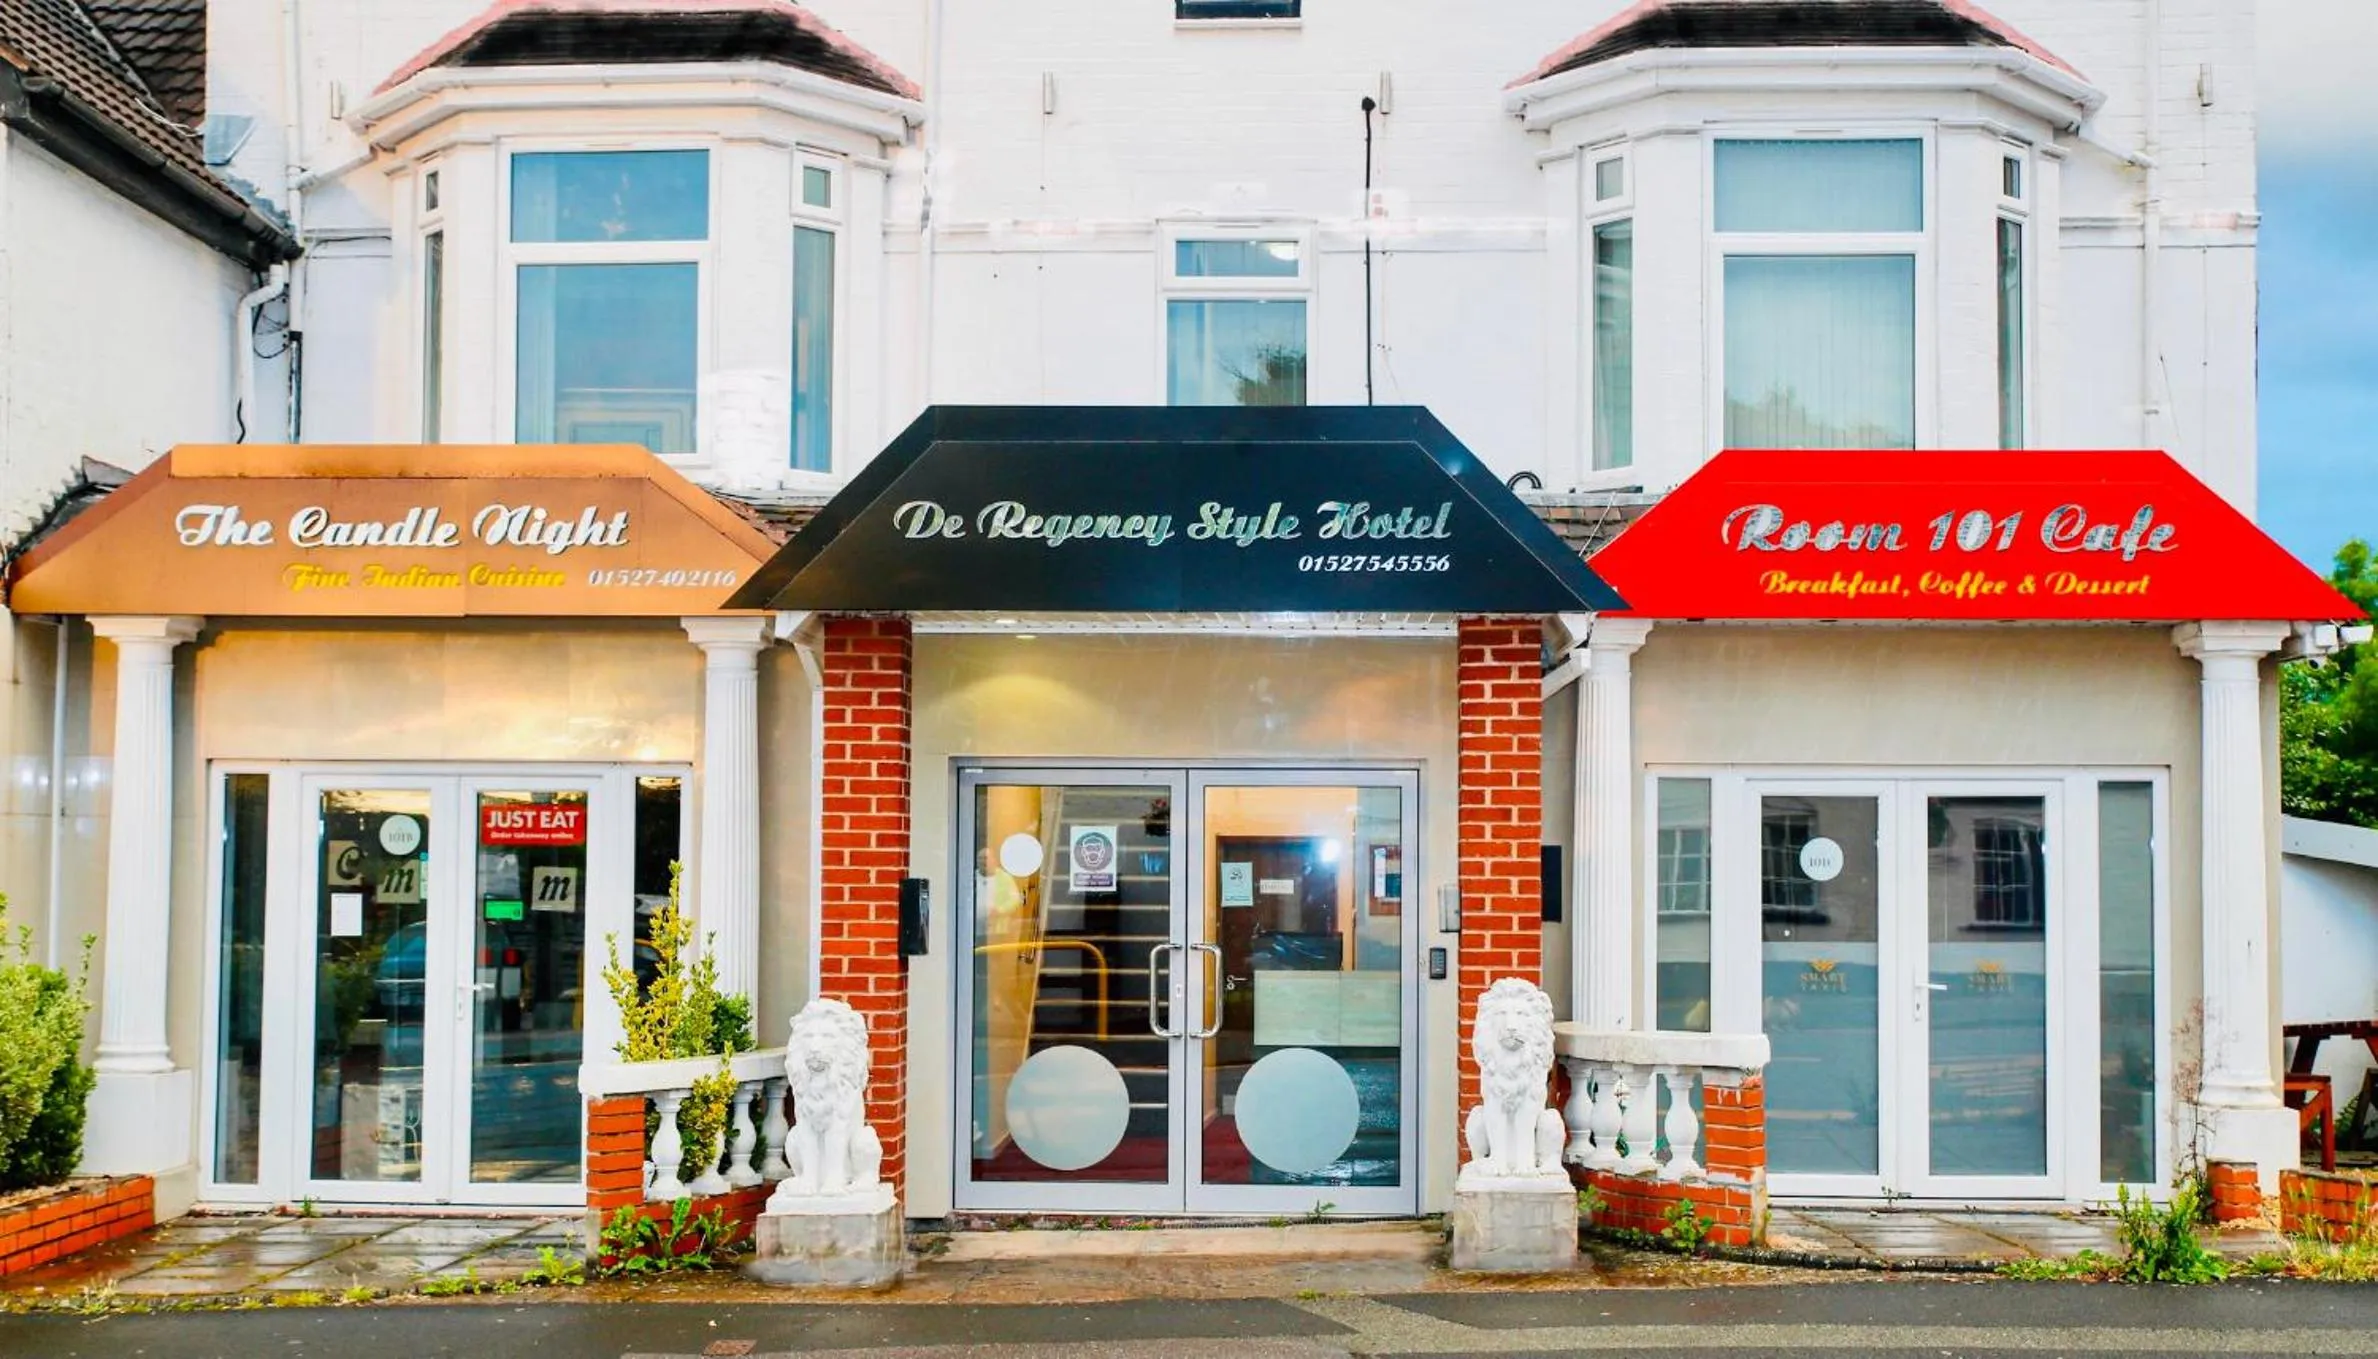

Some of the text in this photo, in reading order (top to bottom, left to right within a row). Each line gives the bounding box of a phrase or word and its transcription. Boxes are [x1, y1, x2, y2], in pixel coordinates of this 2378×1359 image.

[175, 503, 630, 555] The Candle Night
[893, 500, 1453, 548] De Regency Style Hotel
[1721, 503, 2180, 562] Room 101 Cafe
[282, 560, 567, 592] Fine Indian Cuisine
[588, 568, 737, 588] 01527402116
[1298, 554, 1451, 573] 01527545556
[1759, 570, 2151, 599] Breakfast, Coffee & Dessert
[486, 810, 579, 829] JUST EAT
